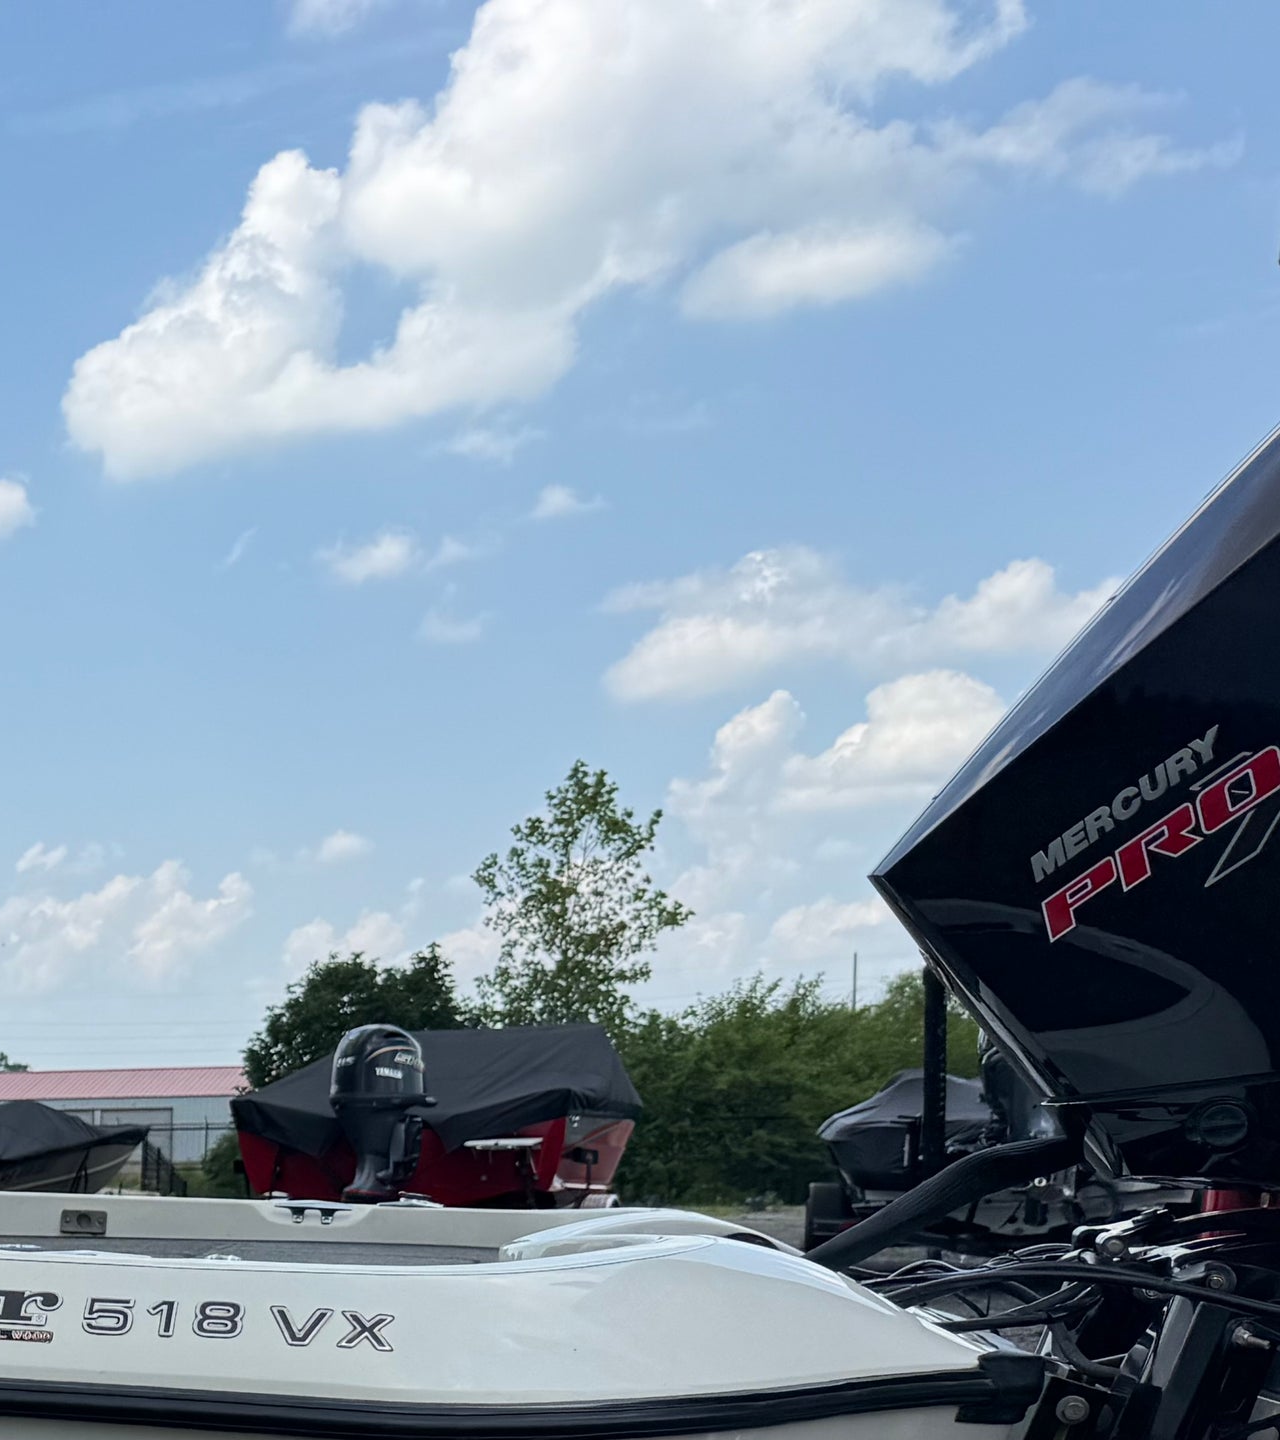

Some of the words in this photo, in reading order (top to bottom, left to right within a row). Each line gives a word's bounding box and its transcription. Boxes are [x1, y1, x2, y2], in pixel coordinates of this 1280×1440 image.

[1030, 724, 1219, 883] MERCURY
[81, 1297, 245, 1338] 518
[269, 1305, 395, 1351] VX
